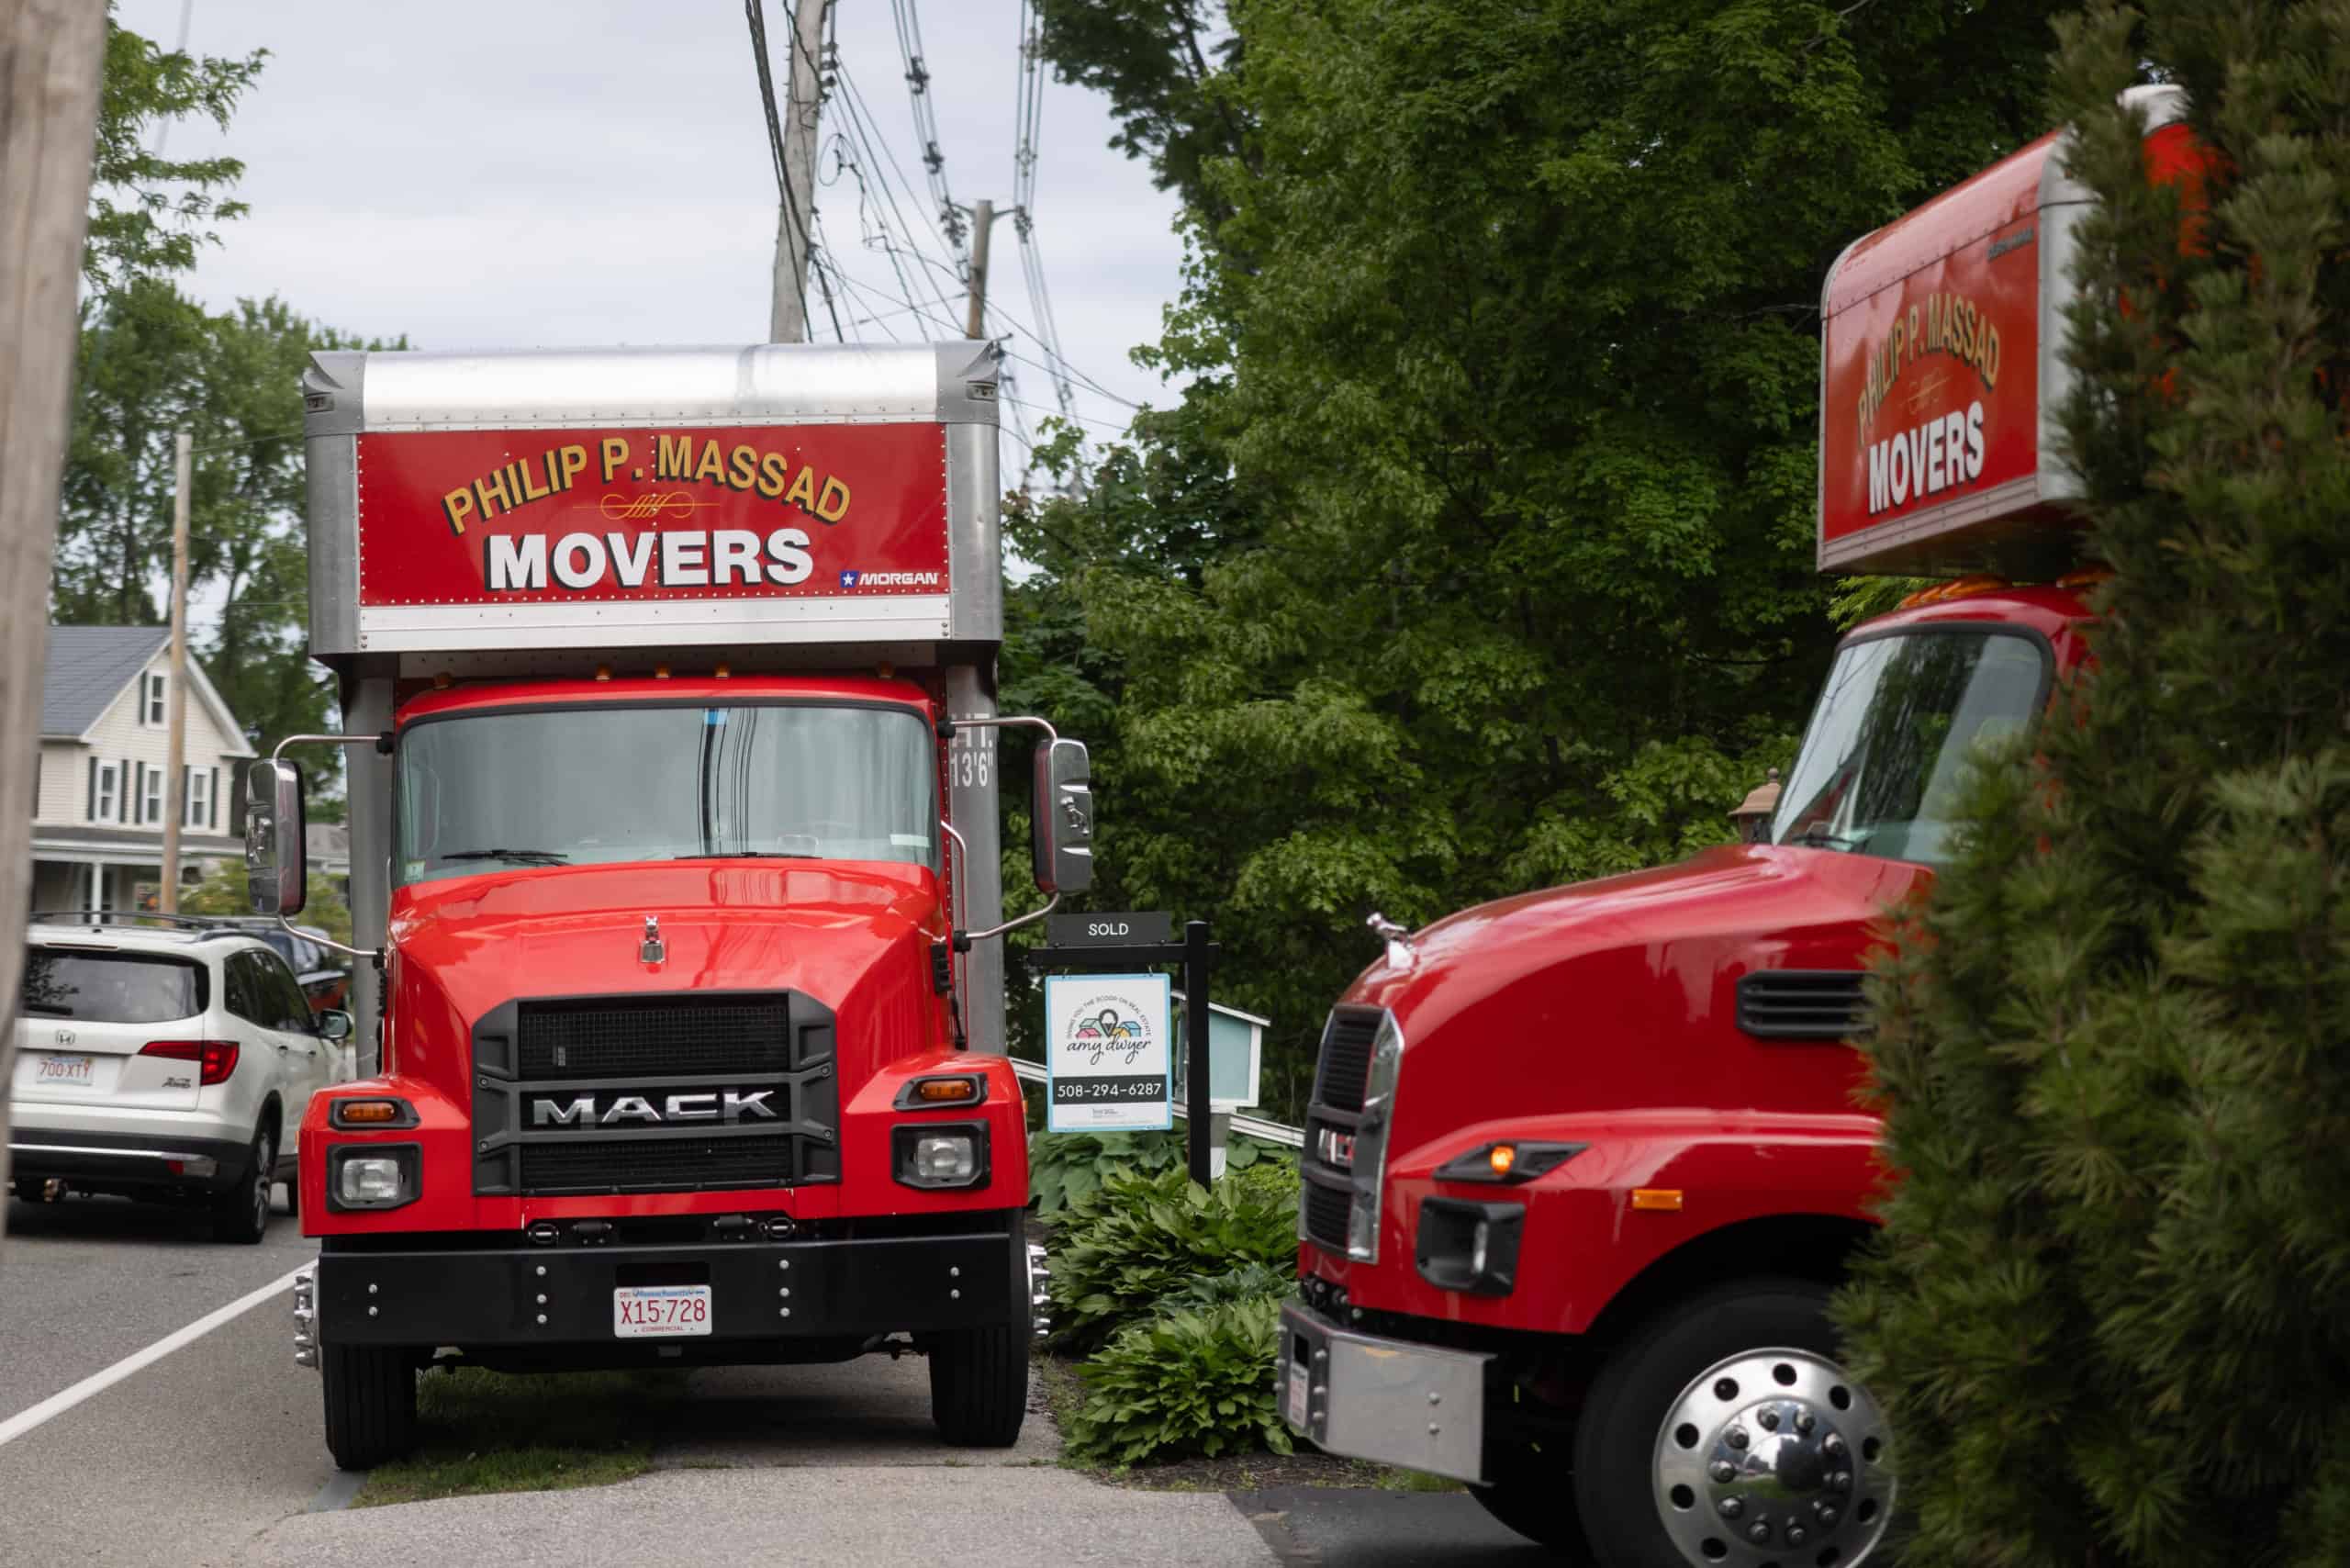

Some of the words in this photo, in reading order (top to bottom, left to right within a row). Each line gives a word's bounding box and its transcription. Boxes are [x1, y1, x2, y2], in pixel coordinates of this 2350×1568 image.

[1928, 294, 2000, 393] MASSAD
[1869, 401, 1984, 514] MOVERS
[442, 444, 588, 535] PHILIP
[601, 437, 643, 483] P.
[656, 435, 852, 524] MASSAD
[486, 528, 813, 590] MOVERS
[859, 572, 938, 586] MORGAN
[1088, 923, 1128, 936] SOLD
[1066, 1042, 1104, 1065] amy
[1105, 1035, 1152, 1065] dwyer
[533, 1090, 777, 1126] MACK
[1058, 1083, 1161, 1097] 508-294-6287
